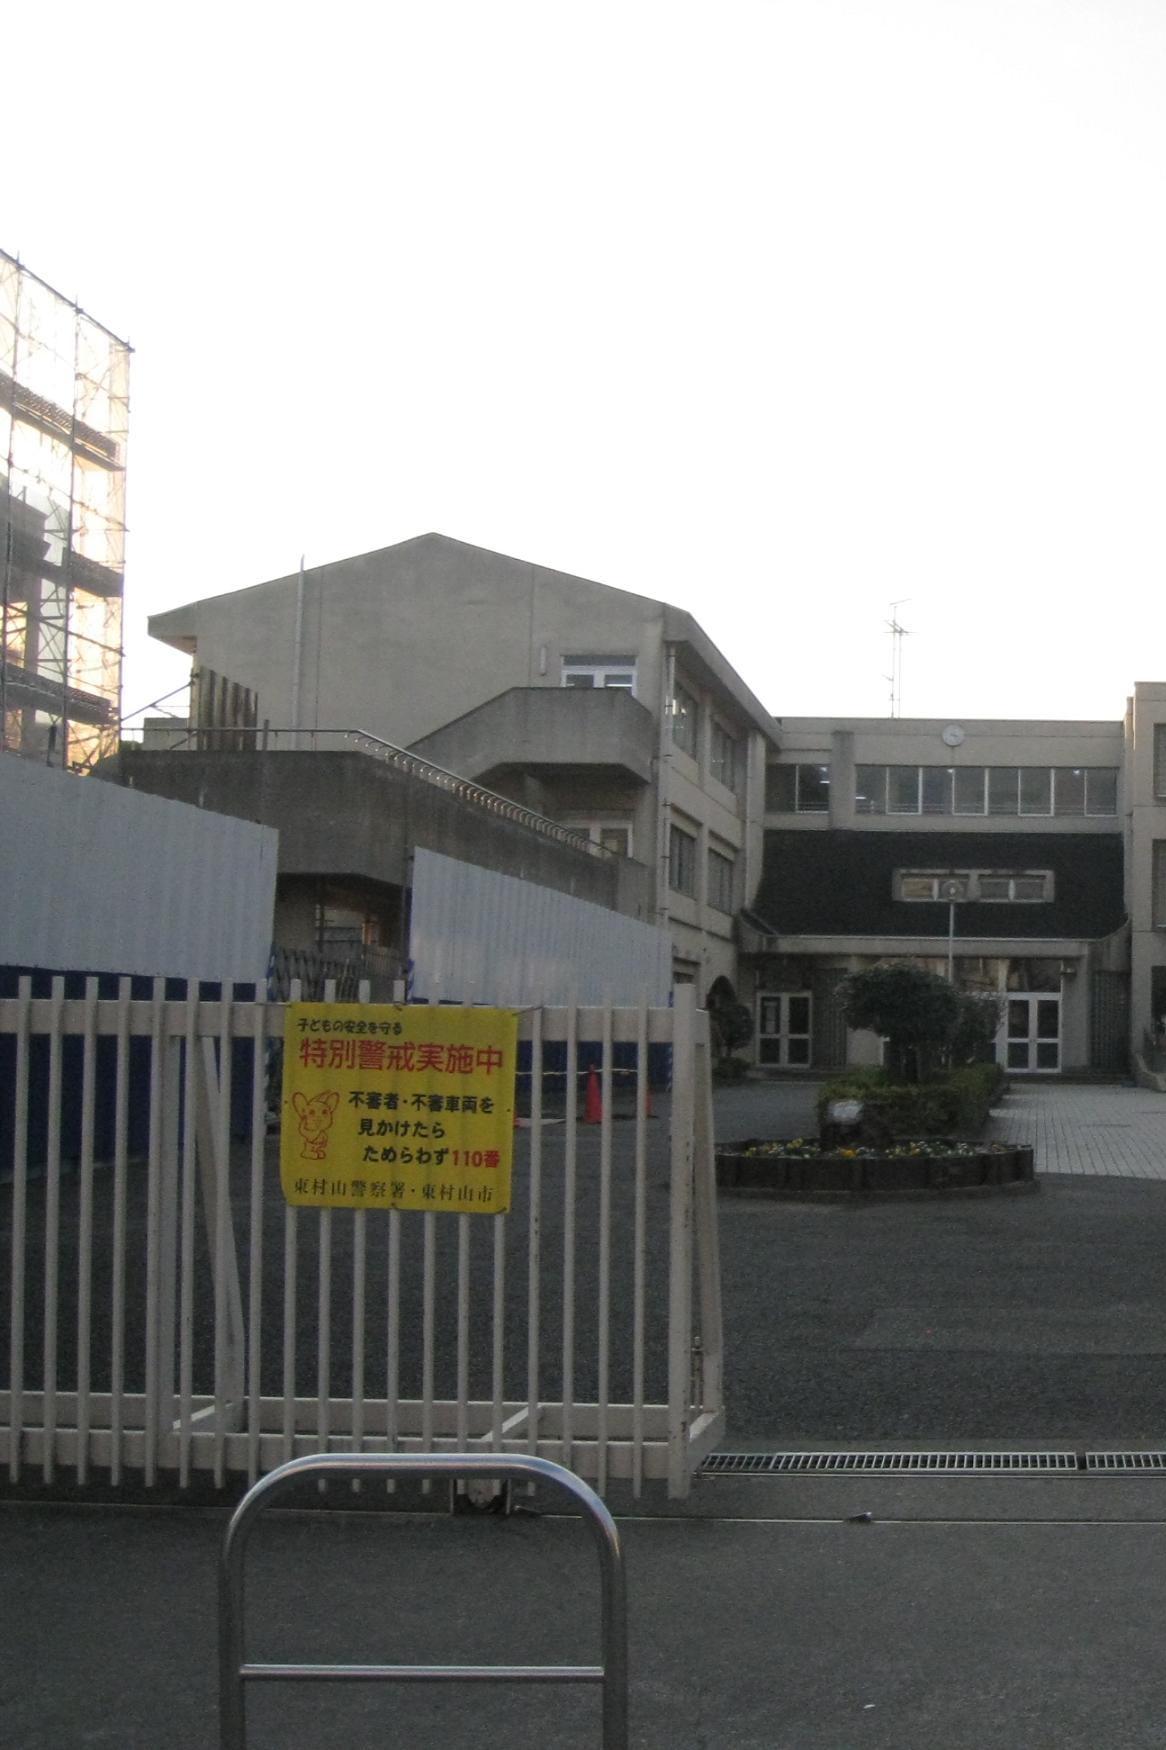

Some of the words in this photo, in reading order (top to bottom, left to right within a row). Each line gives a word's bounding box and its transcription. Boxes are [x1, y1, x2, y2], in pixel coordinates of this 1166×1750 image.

[297, 1018, 403, 1035] 子どもの安全を守る
[300, 1038, 504, 1075] 特別警戒実施中
[348, 1091, 494, 1114] 不審者・不審車両を
[358, 1119, 446, 1138] 見かけたら
[362, 1146, 501, 1168] ためらわず110番
[294, 1178, 493, 1202] 東村山警察署・東村山市
